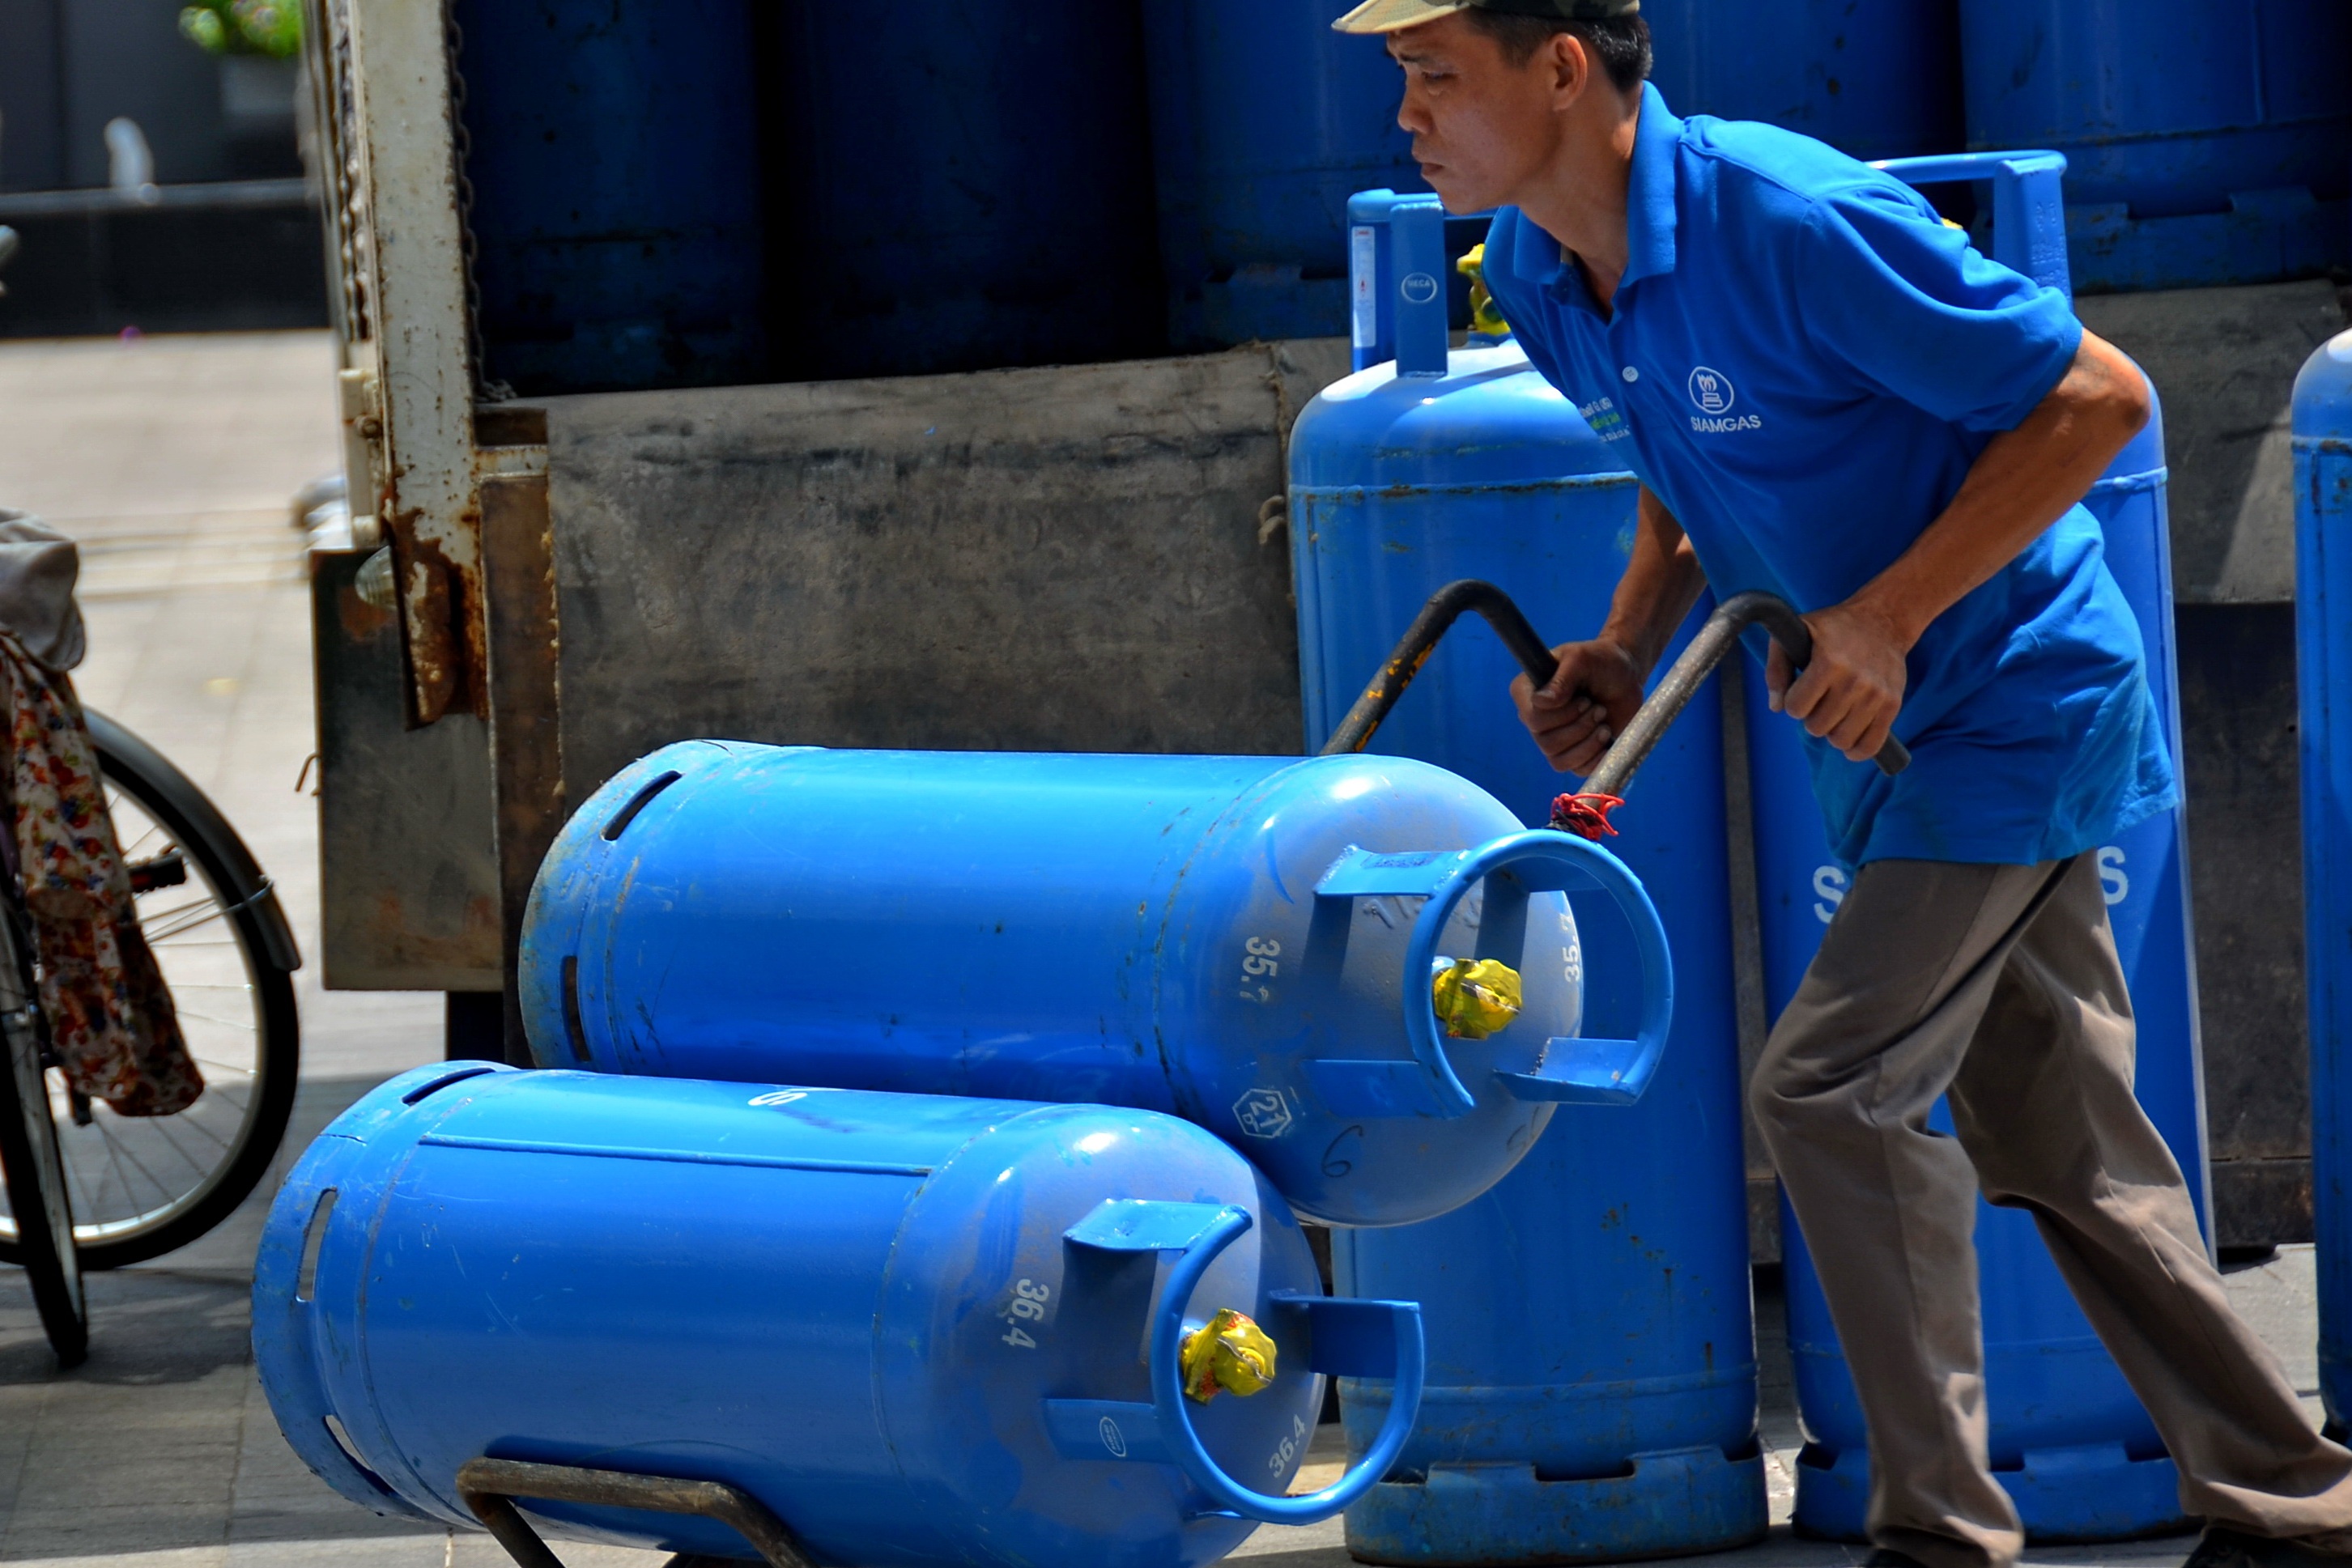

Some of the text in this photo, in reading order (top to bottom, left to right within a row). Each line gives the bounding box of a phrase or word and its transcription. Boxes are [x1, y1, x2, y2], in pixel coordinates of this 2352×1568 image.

[1690, 414, 1762, 433] SIAMGAS
[1002, 1278, 1049, 1349] 36.4
[1269, 1413, 1306, 1478] 36.4
